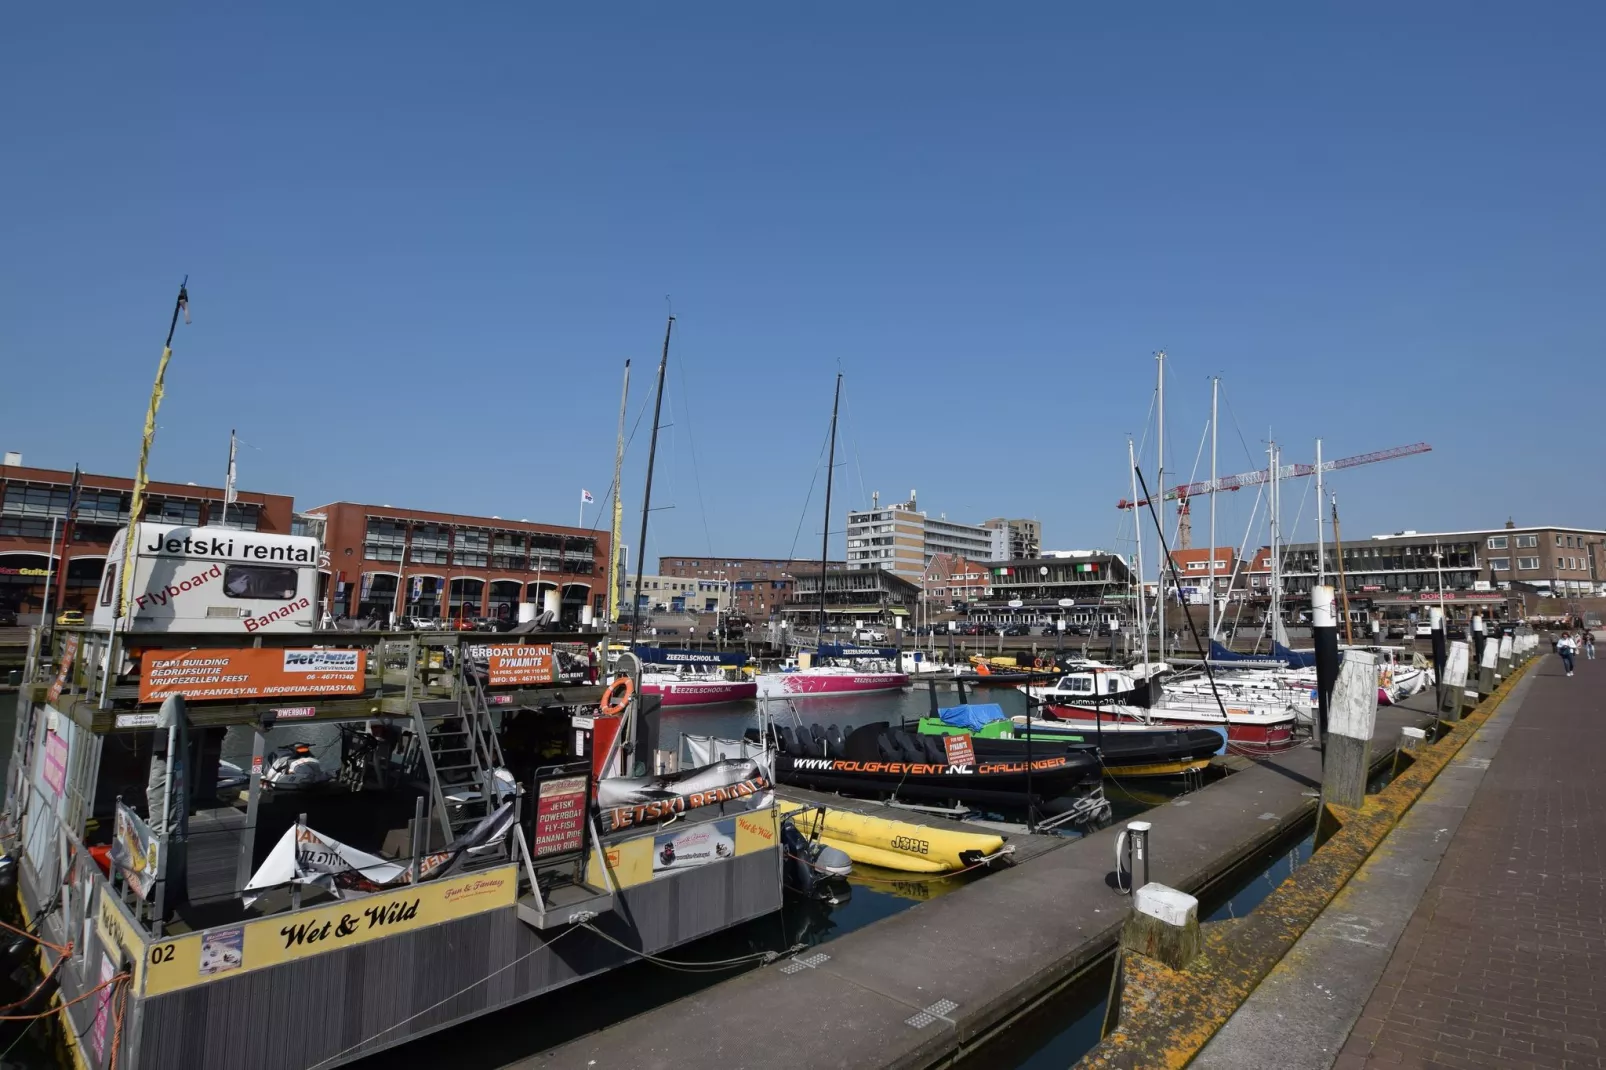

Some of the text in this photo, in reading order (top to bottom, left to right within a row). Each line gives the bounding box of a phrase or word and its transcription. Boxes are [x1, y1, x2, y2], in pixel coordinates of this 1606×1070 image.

[147, 533, 316, 563] Jetski rental
[135, 564, 222, 611] Flyboard
[243, 597, 310, 632] Banana
[516, 647, 551, 656] 070.NL
[666, 654, 721, 662] ZEEZEILSCHOOL.NL
[151, 658, 230, 668] TEAM BUILDING
[499, 657, 543, 668] DYNAMITE
[150, 667, 222, 676] BEDRIJFSUITJE
[150, 676, 220, 686] VRIJGEZELLEN
[150, 685, 357, 699] WWWFUN-FANTASY.NL INFO@FUN-FANTASY.NL
[278, 708, 310, 716] OWERBOAT
[793, 758, 974, 775] WWW.ROUGHEVENT.NL
[978, 757, 1066, 775] CHALLENGER
[550, 800, 574, 811] JETSKI
[540, 808, 582, 823] POWERBOAT
[610, 796, 685, 831] JETSKI
[545, 820, 576, 832] FLY-FISH
[738, 818, 774, 840] Wet & Wild
[536, 830, 582, 845] BANANA RIDE
[538, 840, 578, 856] SONAR RIDE
[444, 888, 462, 899] Fun
[464, 884, 472, 892] &
[473, 880, 504, 890] Fantasy
[280, 898, 421, 950] Wet & Wild
[152, 944, 176, 966] 02
